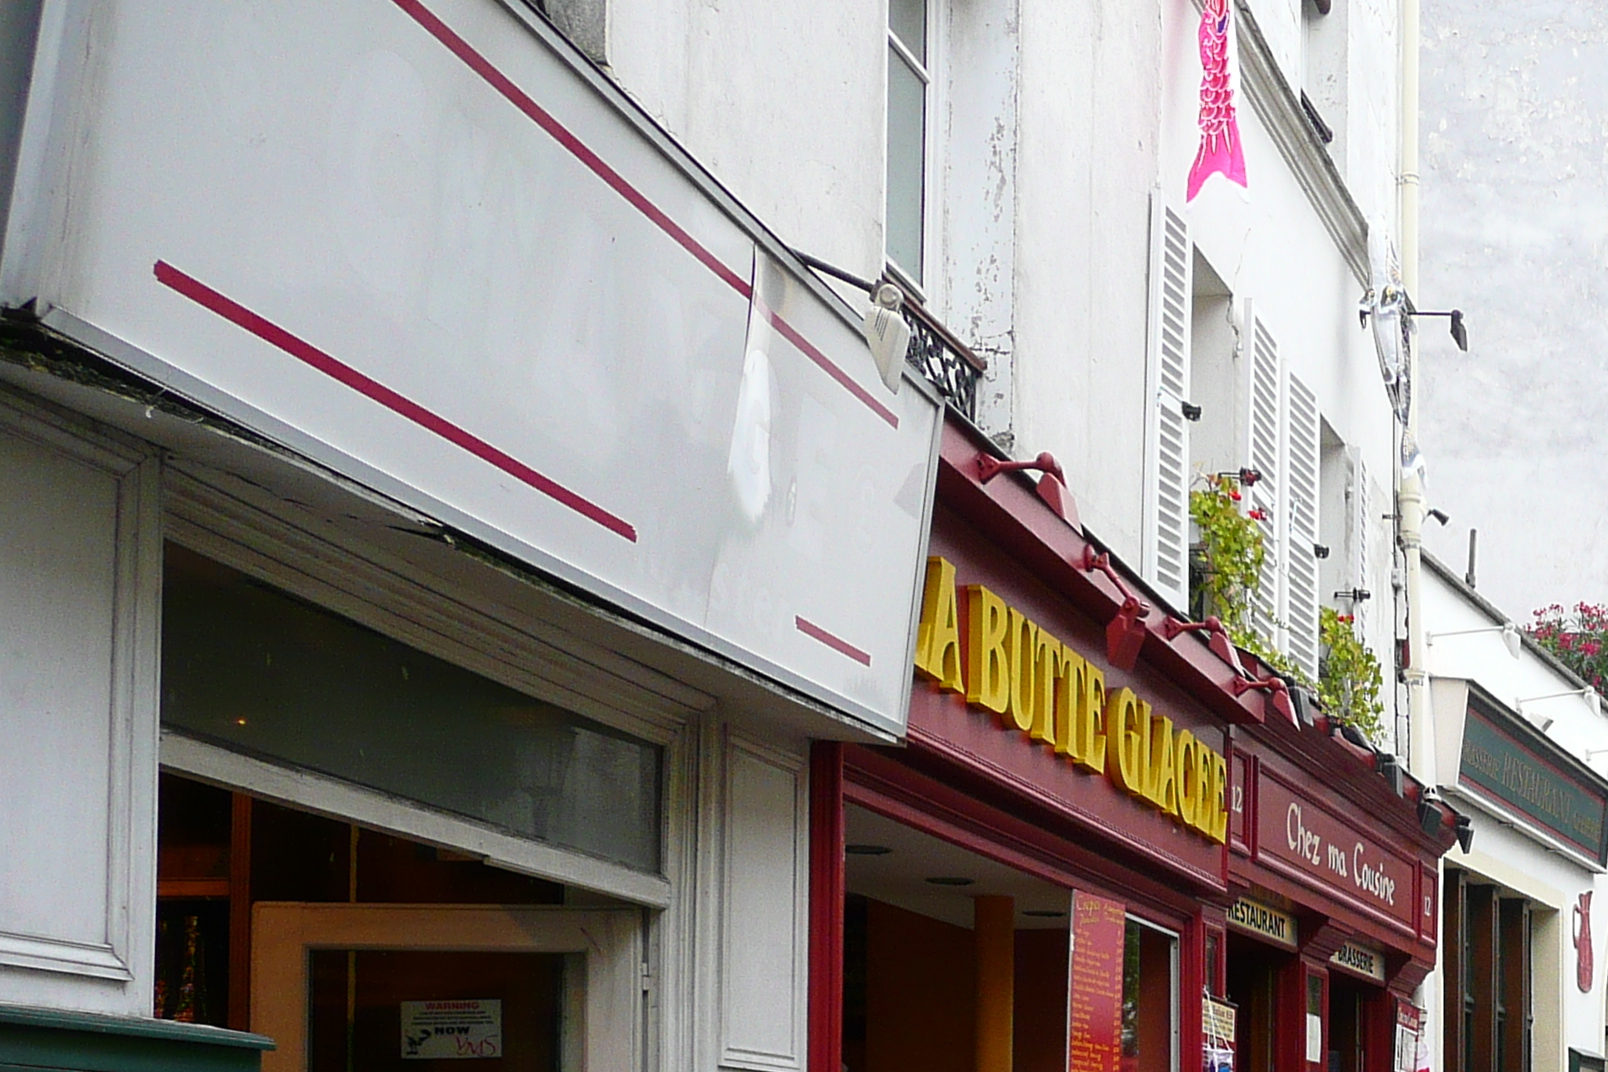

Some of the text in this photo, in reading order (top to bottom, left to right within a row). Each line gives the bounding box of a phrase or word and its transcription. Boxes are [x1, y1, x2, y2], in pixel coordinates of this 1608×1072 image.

[966, 583, 1107, 776] BUTTE
[1231, 786, 1243, 814] 12
[1287, 803, 1396, 906] Chez ma Cousine
[1228, 900, 1286, 940] RESTAURANT
[1424, 896, 1432, 917] 12
[425, 1002, 481, 1011] WARNING
[434, 1026, 471, 1035] NOW
